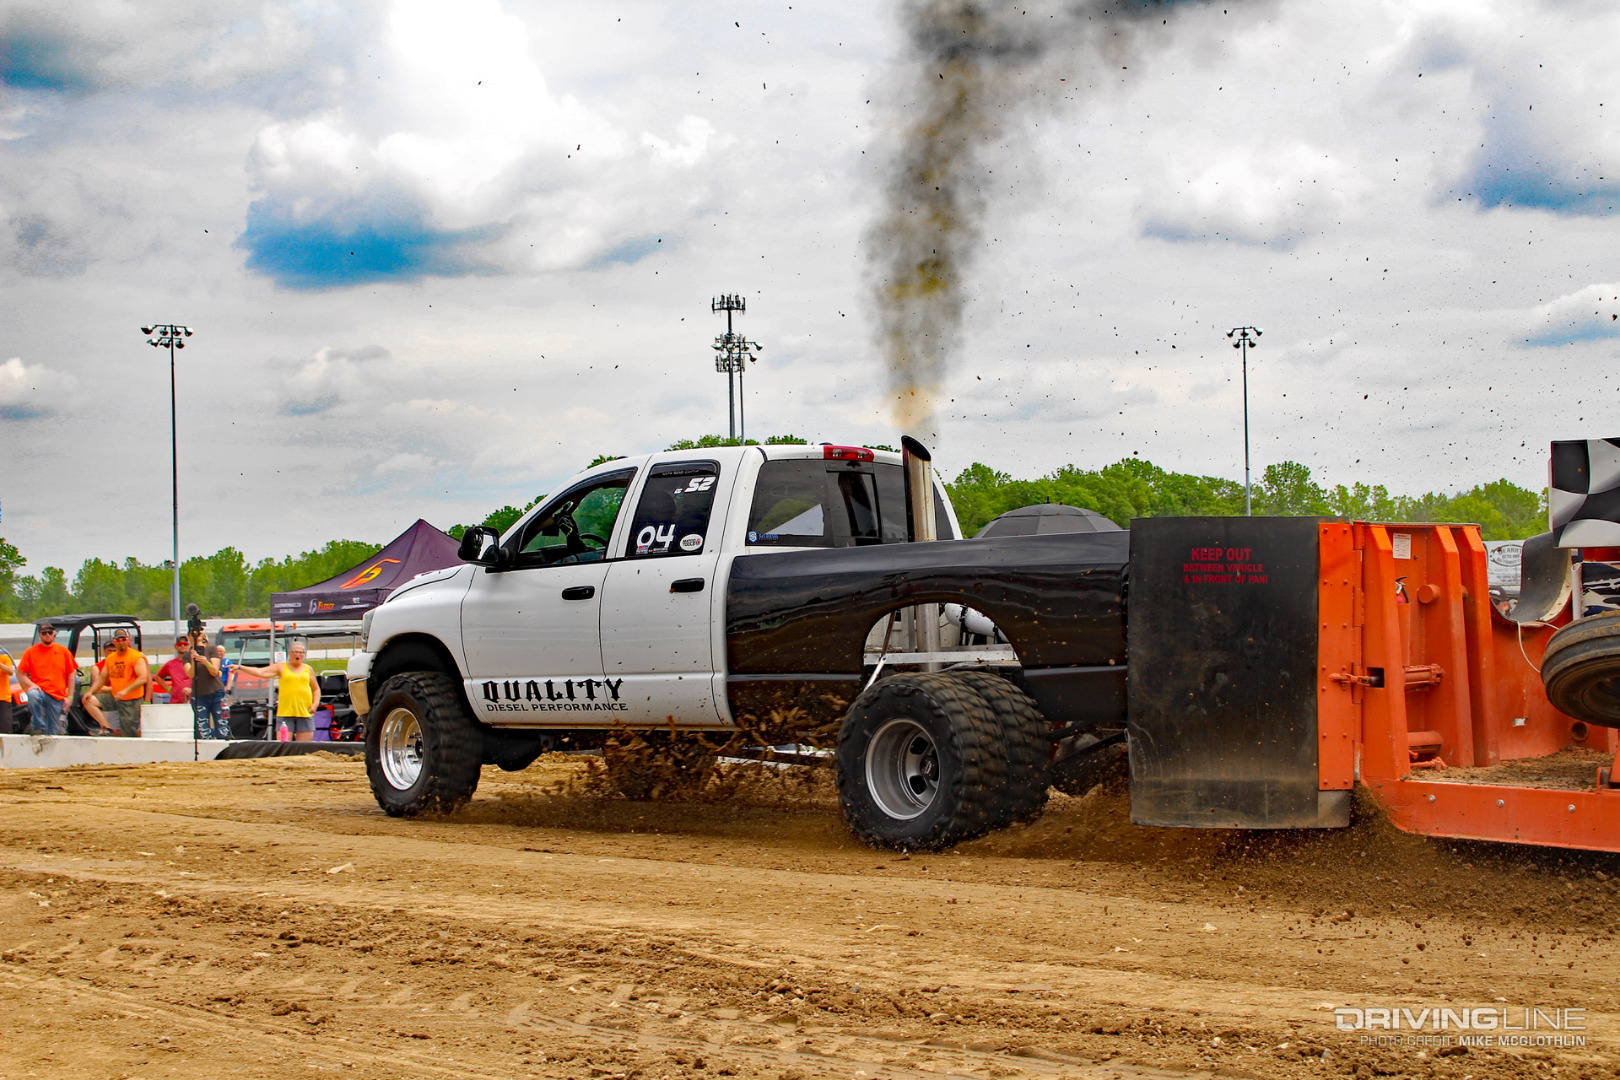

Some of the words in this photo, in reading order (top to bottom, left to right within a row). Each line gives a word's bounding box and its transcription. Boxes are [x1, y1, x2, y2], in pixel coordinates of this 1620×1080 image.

[684, 476, 716, 493] 52
[636, 524, 676, 549] 04
[1191, 547, 1223, 561] KEEP
[1226, 547, 1252, 561] OUT
[1183, 564, 1225, 572] BETWEEN
[1226, 564, 1264, 572] VEHICLE
[1183, 575, 1190, 583] &
[1192, 575, 1202, 583] IN
[1204, 575, 1233, 583] FRONT
[1234, 575, 1247, 583] OF
[481, 678, 624, 703] QUALITY
[486, 703, 529, 712] DIESEL
[532, 703, 629, 712] PERFORMANCE
